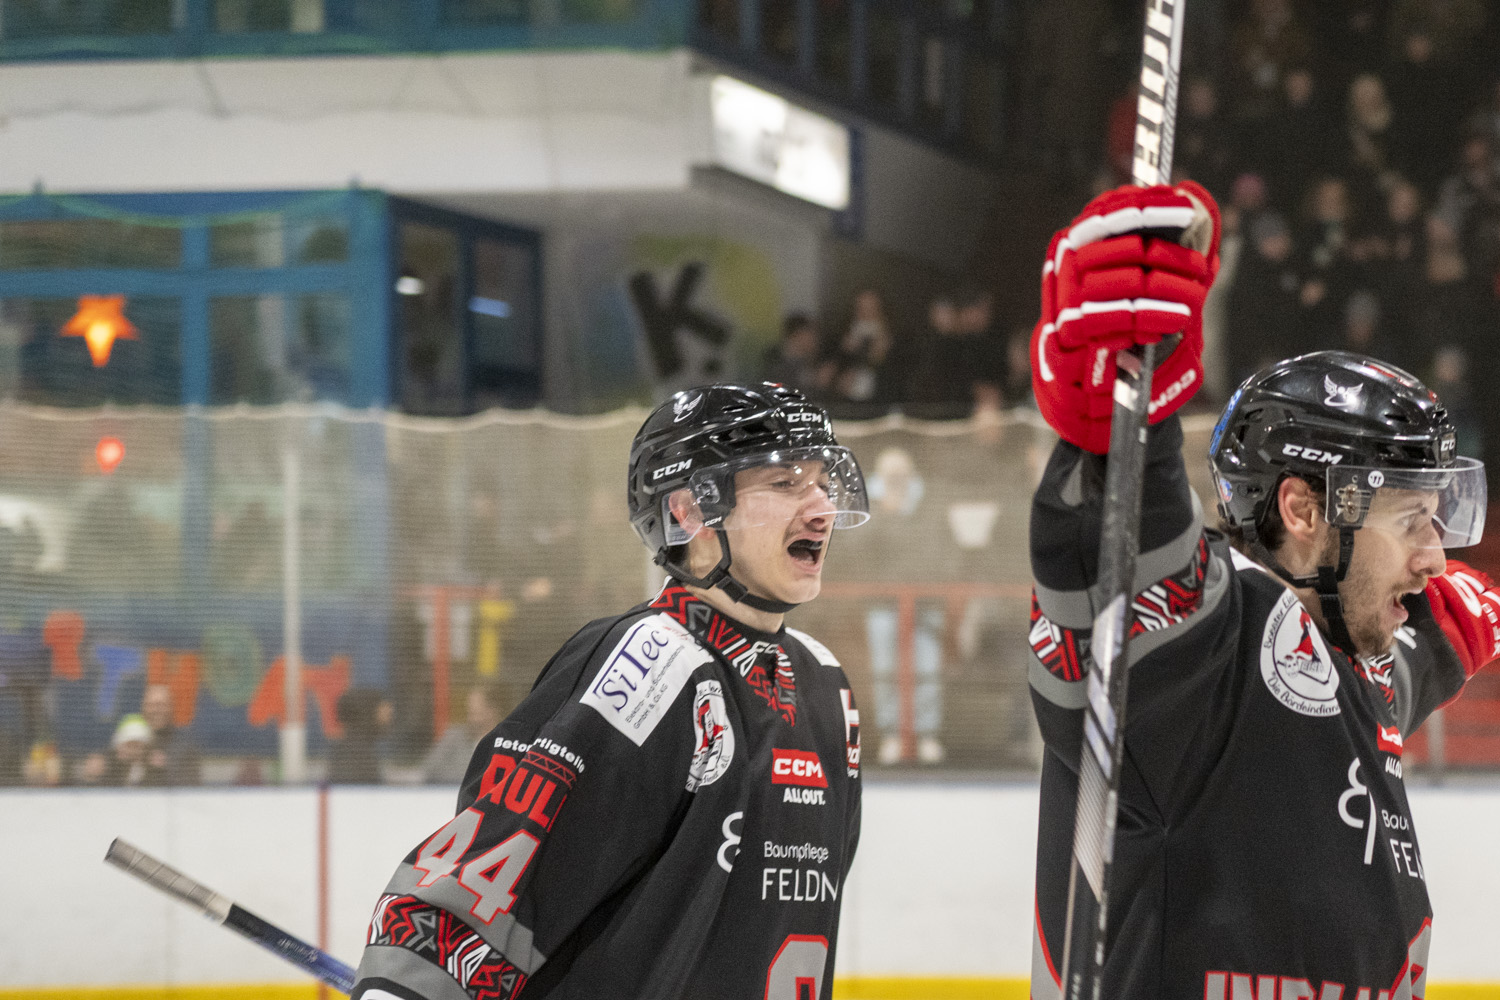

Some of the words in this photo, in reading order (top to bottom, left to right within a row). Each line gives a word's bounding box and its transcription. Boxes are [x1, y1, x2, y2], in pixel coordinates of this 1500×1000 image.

[787, 413, 822, 423] CCM
[1282, 443, 1343, 464] CCM
[653, 458, 693, 480] CCM
[593, 623, 669, 713] SiTec
[774, 758, 822, 778] CCM
[413, 806, 541, 926] 44
